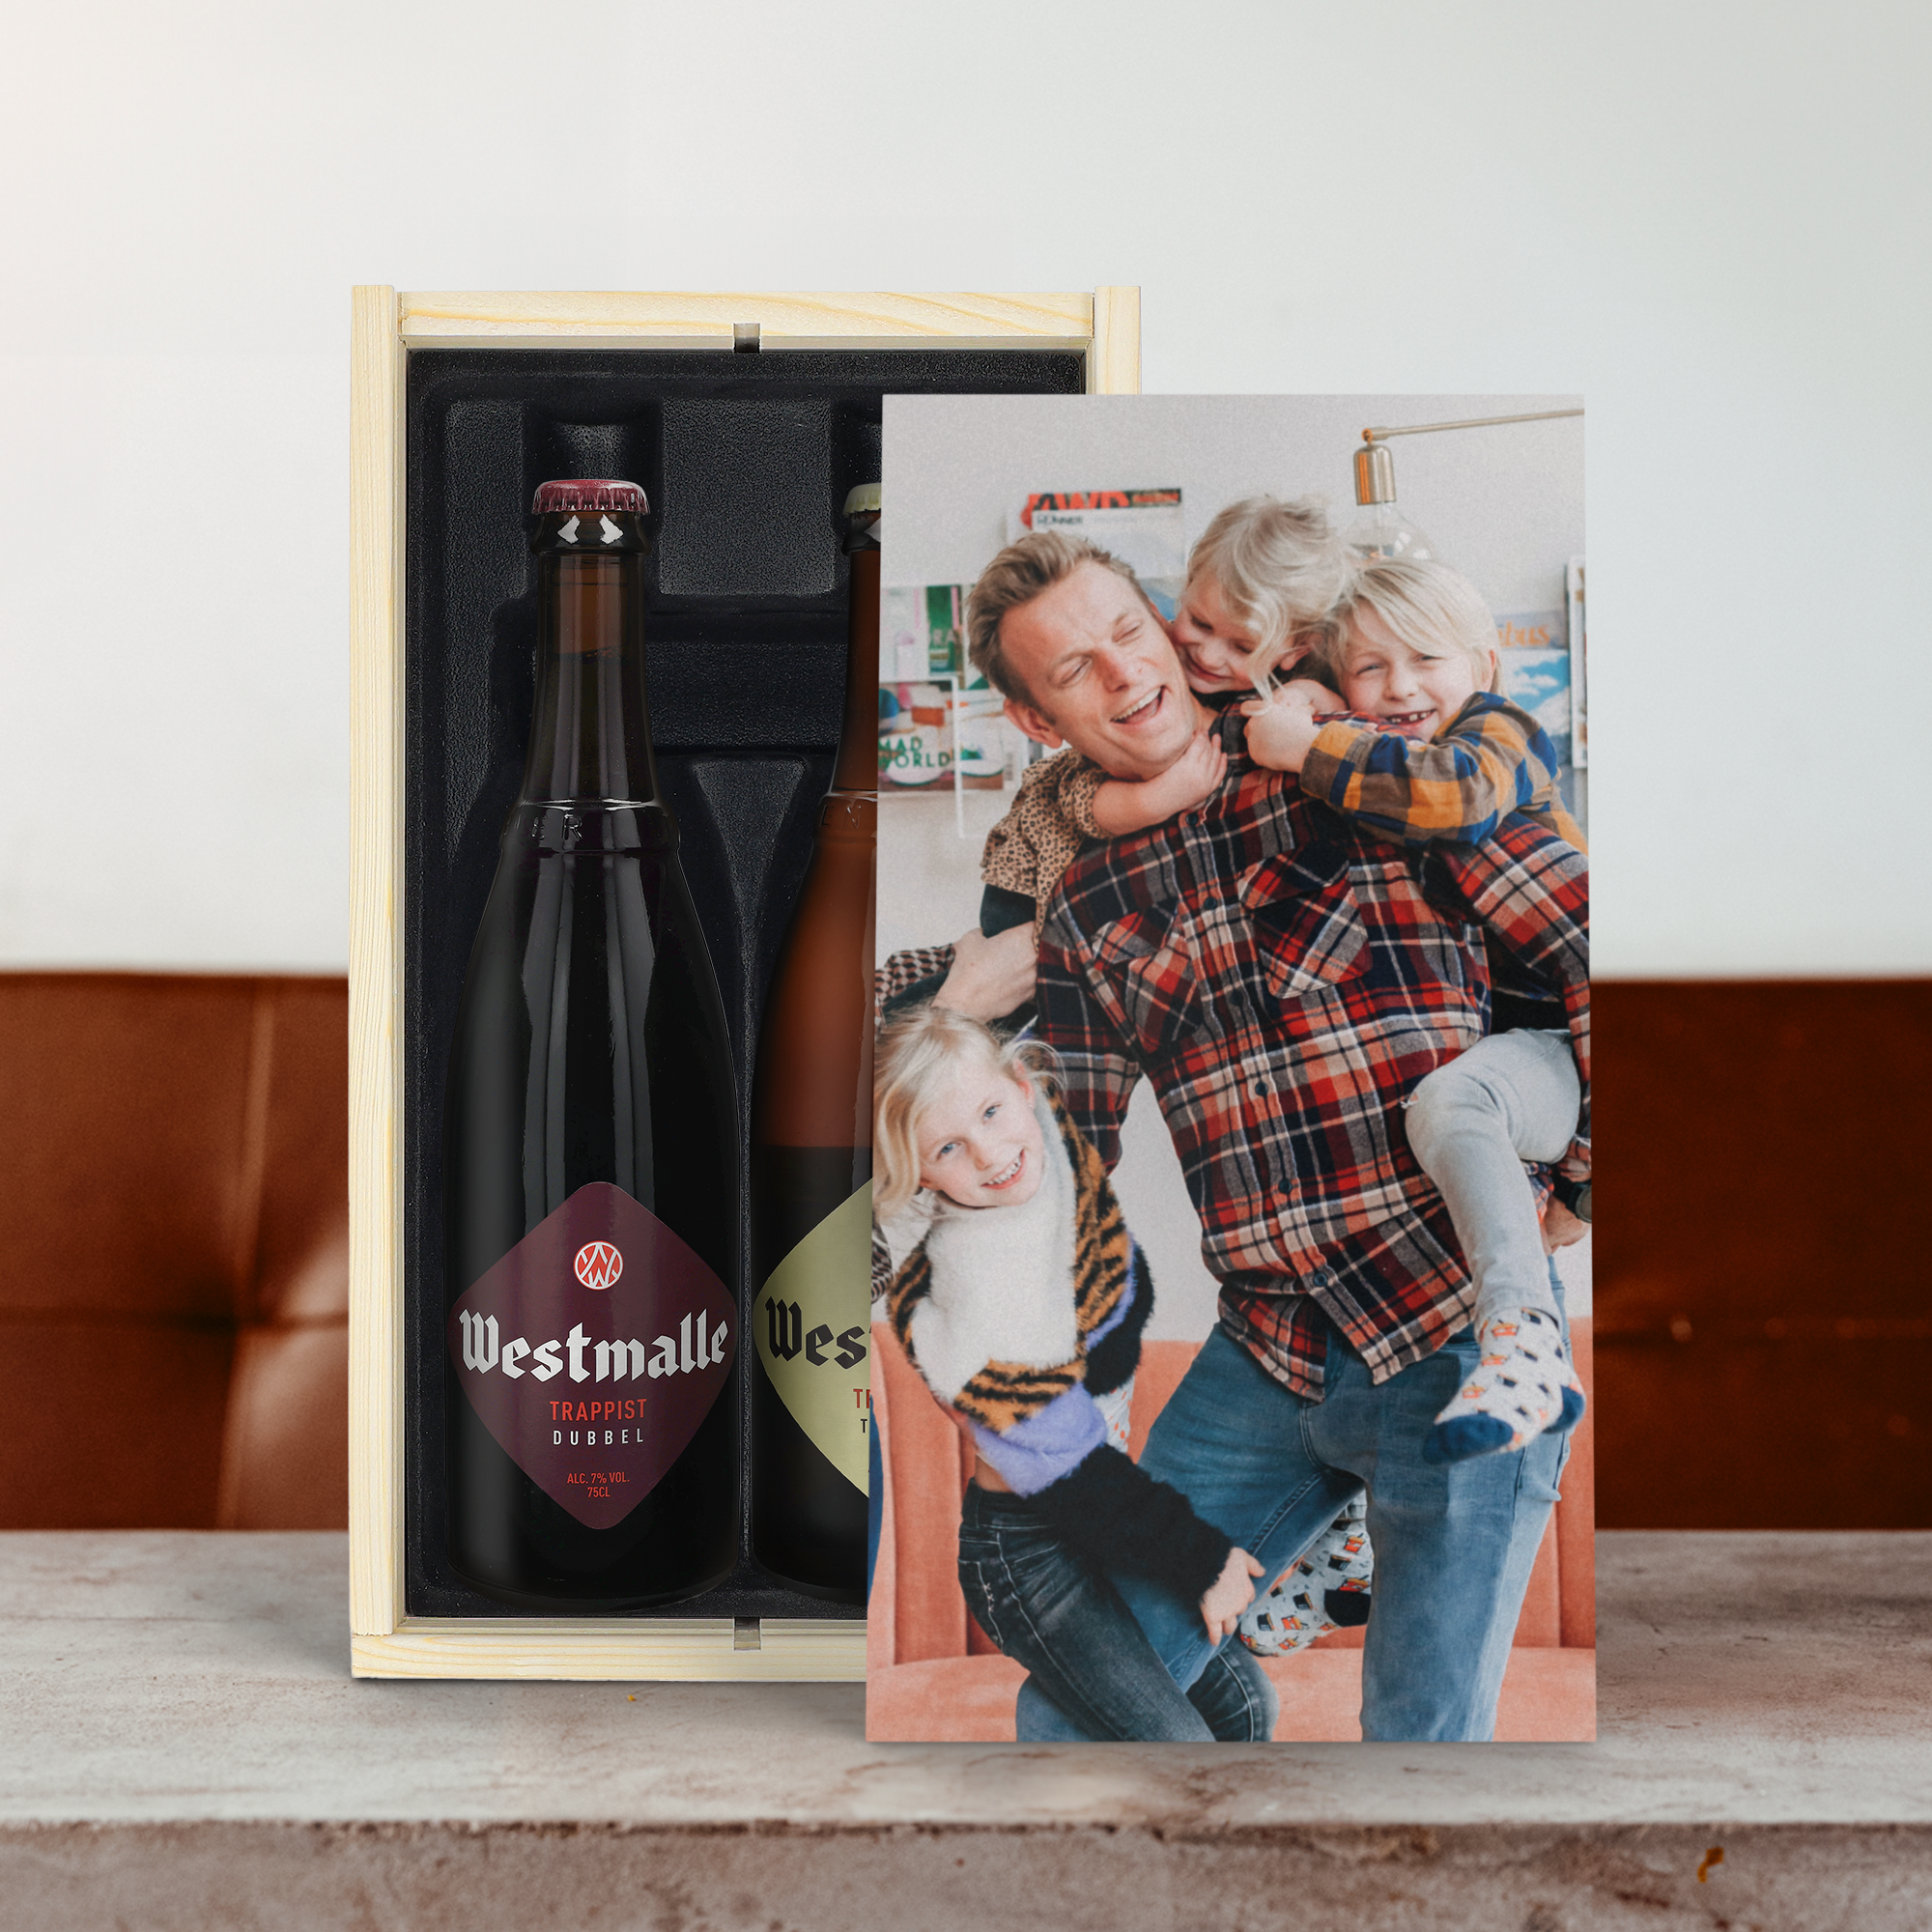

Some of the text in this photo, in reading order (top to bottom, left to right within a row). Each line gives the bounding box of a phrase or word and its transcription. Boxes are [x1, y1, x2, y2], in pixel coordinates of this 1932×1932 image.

[878, 736, 923, 753] MAD
[878, 752, 951, 770] WORLD
[765, 1295, 871, 1370] Wes
[458, 1308, 729, 1383] Westmalle
[549, 1398, 647, 1421] TRAPPIST
[553, 1428, 644, 1446] DUBBEL
[566, 1471, 630, 1484] ALC. 7% VOL.
[586, 1486, 611, 1498] 75CL
